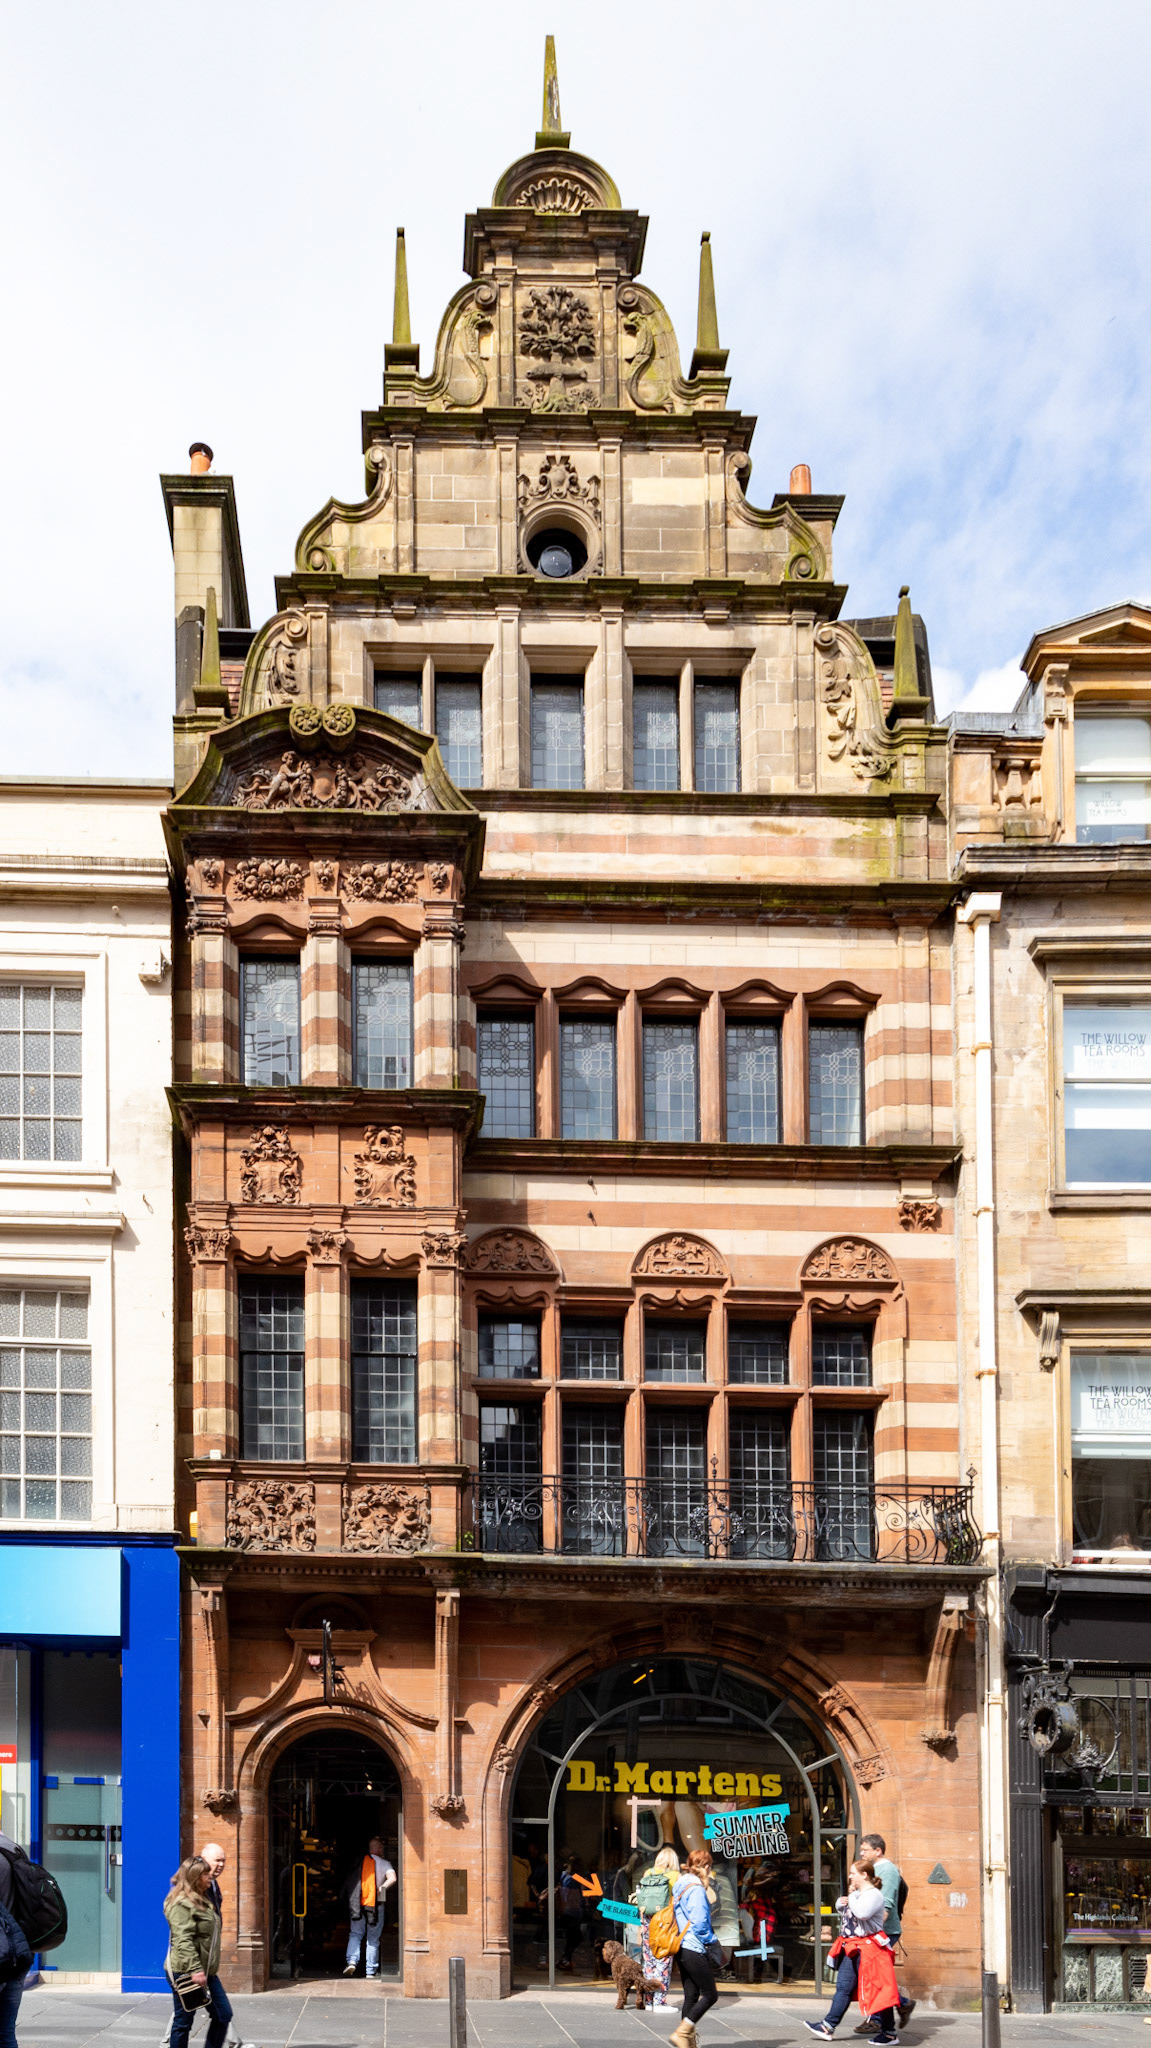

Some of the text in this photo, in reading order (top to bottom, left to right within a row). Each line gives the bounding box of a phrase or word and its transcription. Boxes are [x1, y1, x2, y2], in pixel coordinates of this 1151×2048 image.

[1081, 1033, 1147, 1045] THE WILLOW
[1083, 1045, 1146, 1056] TEA ROOMS
[1088, 1385, 1109, 1397] THE
[1090, 1397, 1110, 1409] TEA
[614, 1761, 783, 1797] Martens
[713, 1812, 785, 1838] SUMMER
[711, 1832, 790, 1859] IS CALLING
[602, 1904, 612, 1913] THE
[1073, 1912, 1084, 1921] The
[1112, 1913, 1138, 1921] Collection
